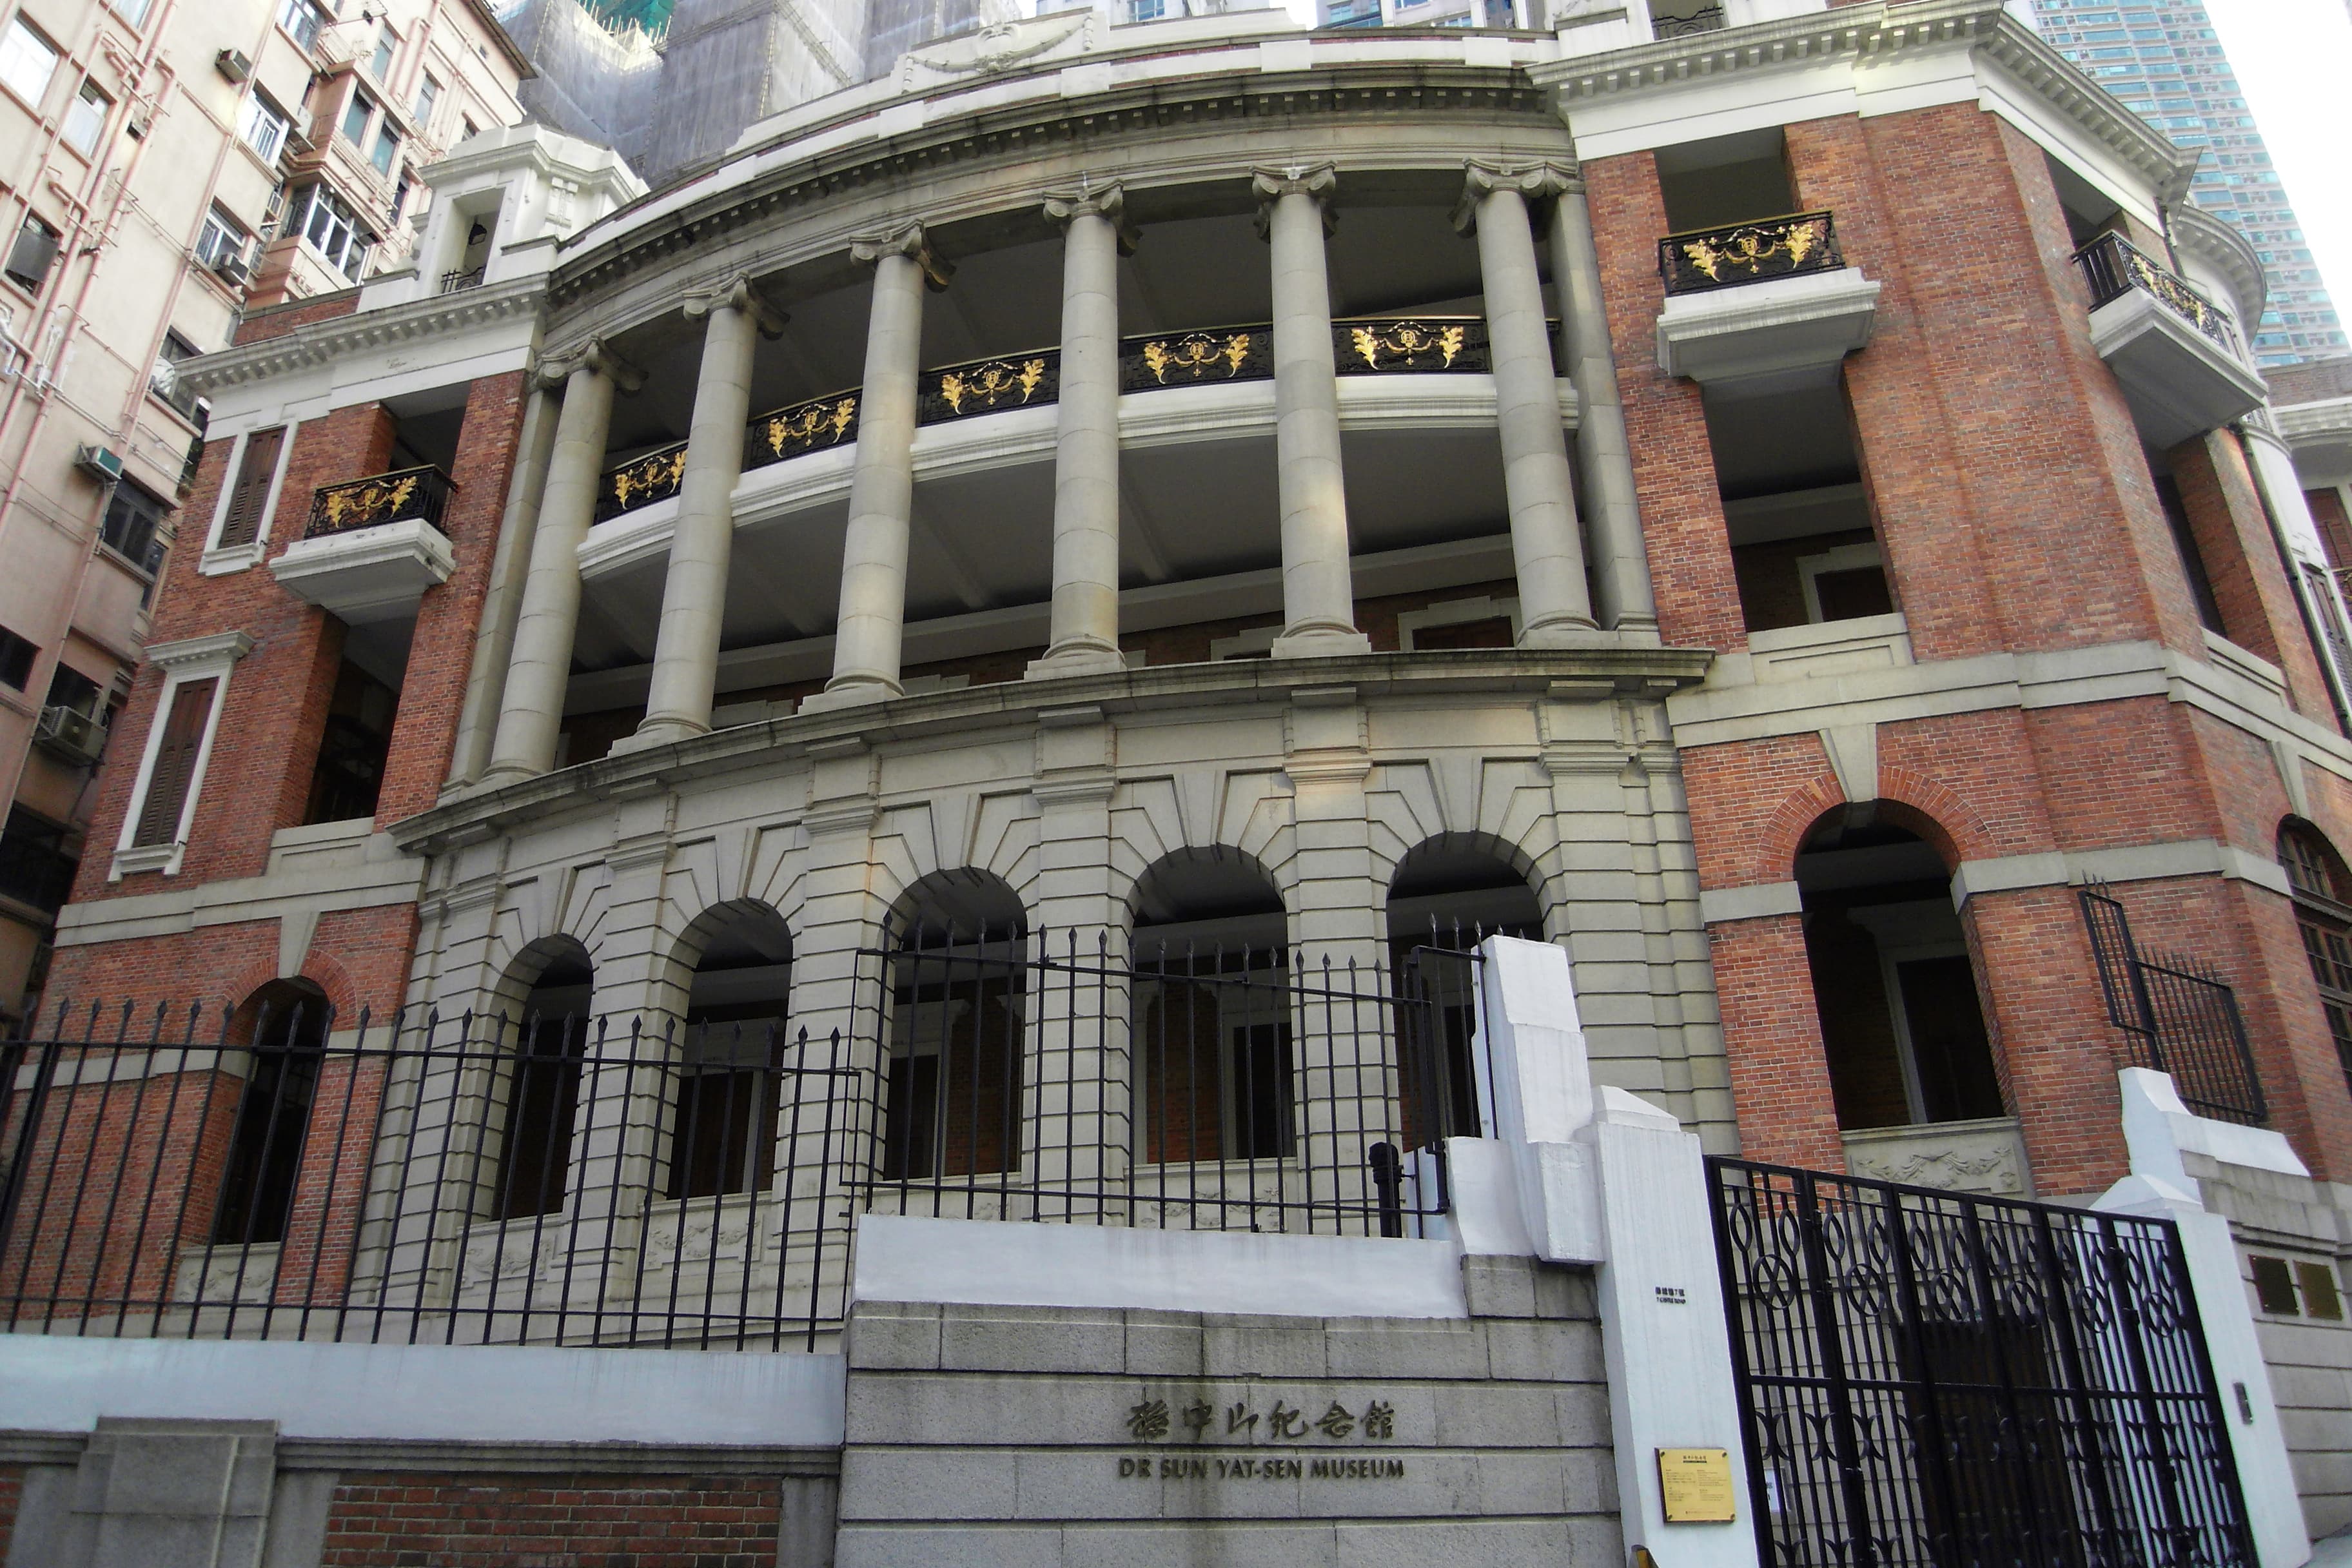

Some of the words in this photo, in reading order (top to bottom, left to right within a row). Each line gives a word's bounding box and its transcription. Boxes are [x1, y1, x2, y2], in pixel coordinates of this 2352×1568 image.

[1119, 1458, 1151, 1477] DR
[1161, 1458, 1207, 1479] SUN
[1216, 1458, 1302, 1478] YAT-SEN
[1310, 1459, 1404, 1478] MUSEUM
